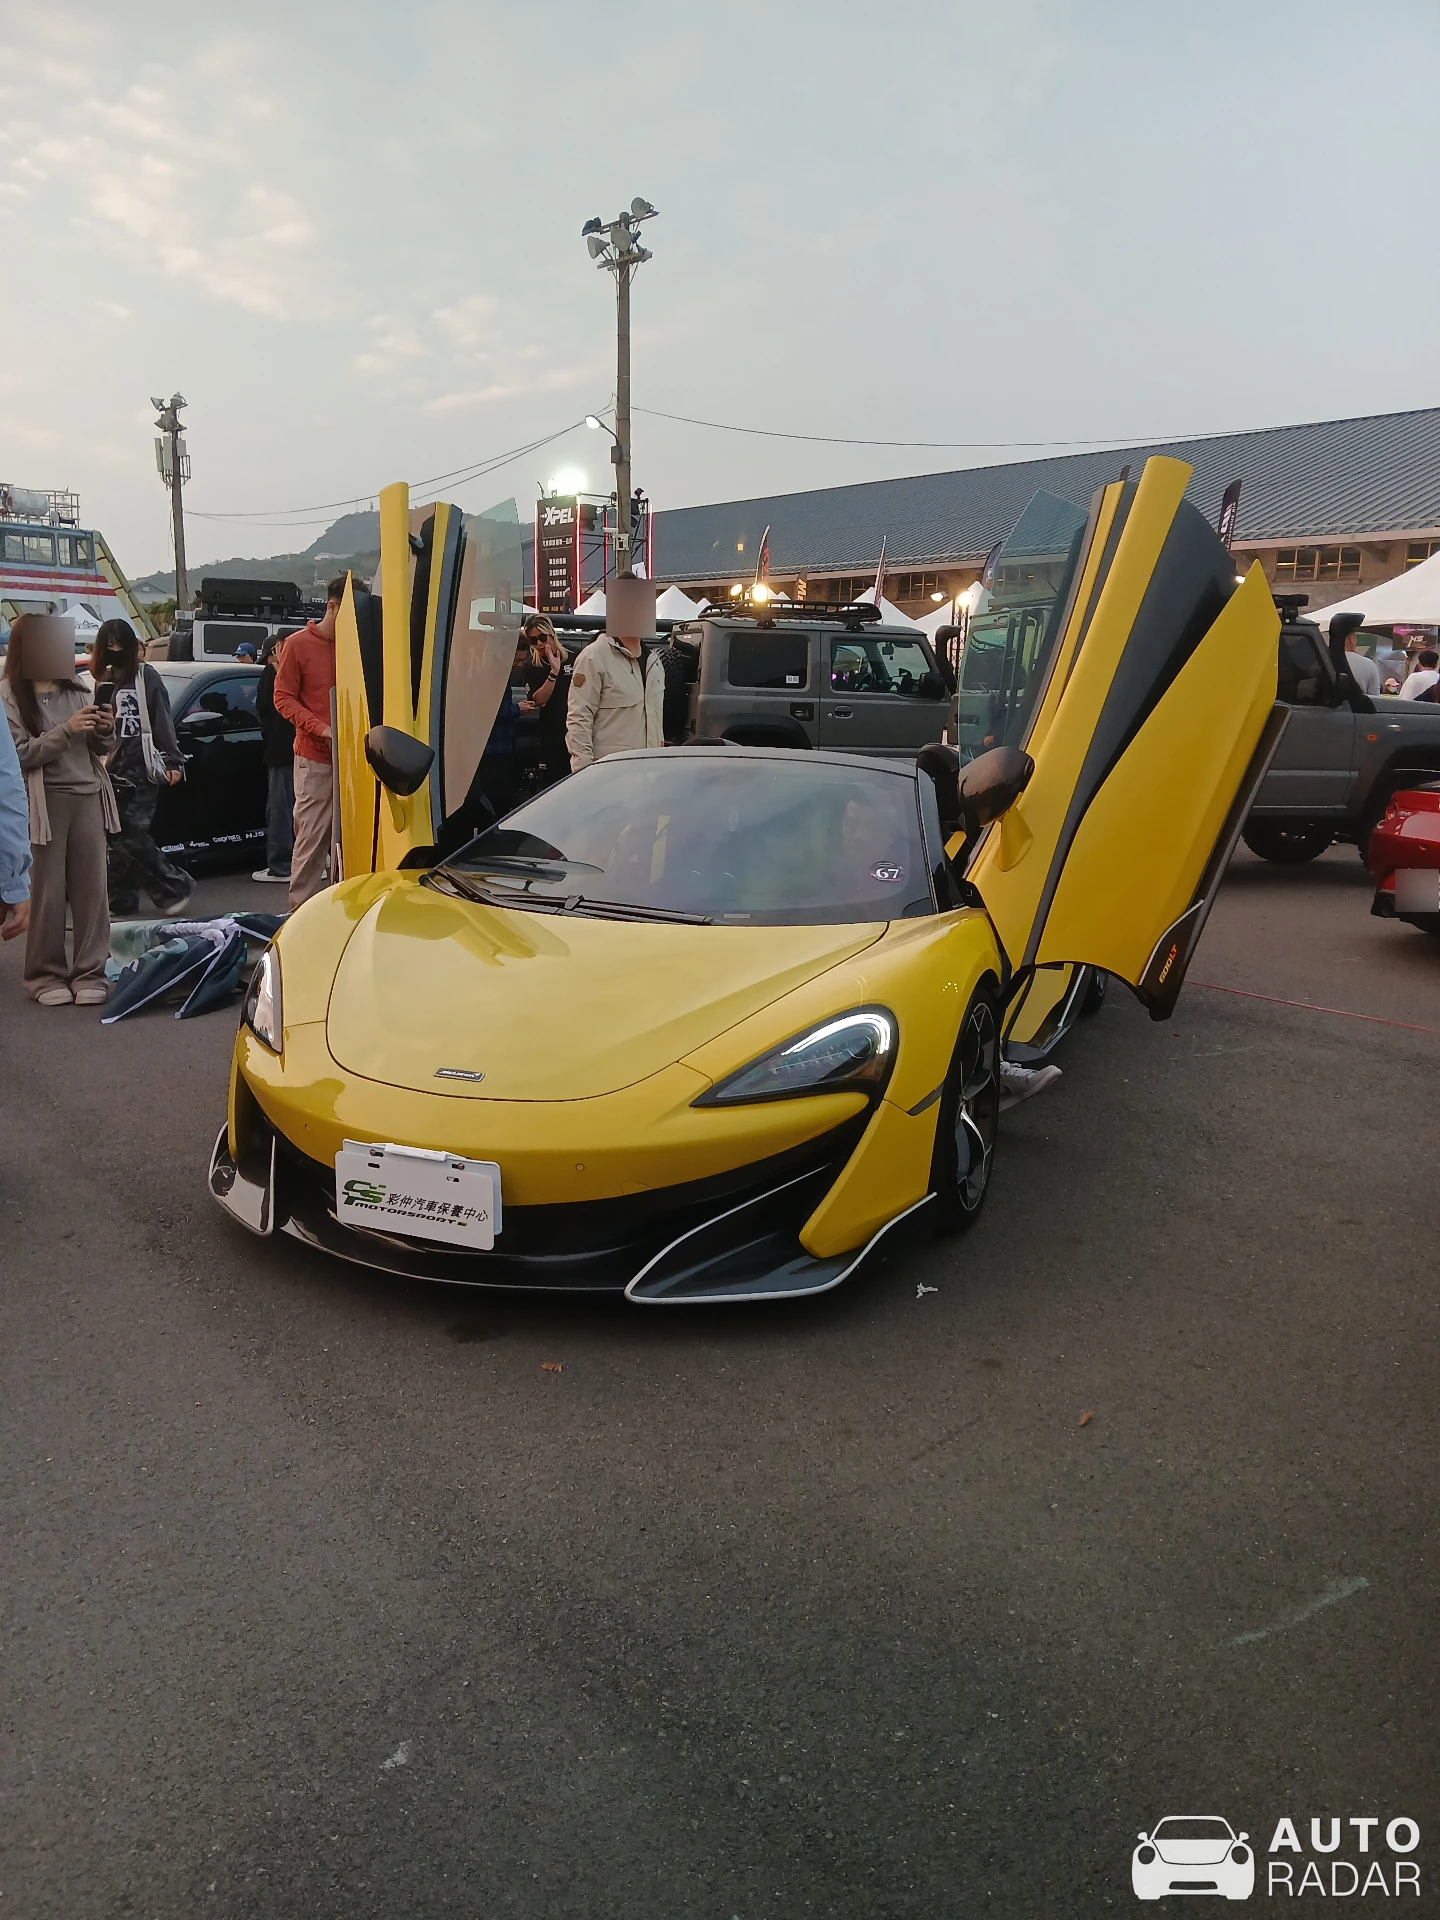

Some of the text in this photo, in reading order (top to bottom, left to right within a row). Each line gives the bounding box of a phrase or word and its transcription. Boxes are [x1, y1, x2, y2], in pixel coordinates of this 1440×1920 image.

[544, 506, 574, 526] XPEL
[386, 1193, 489, 1222] 彩仲汽車保養中心
